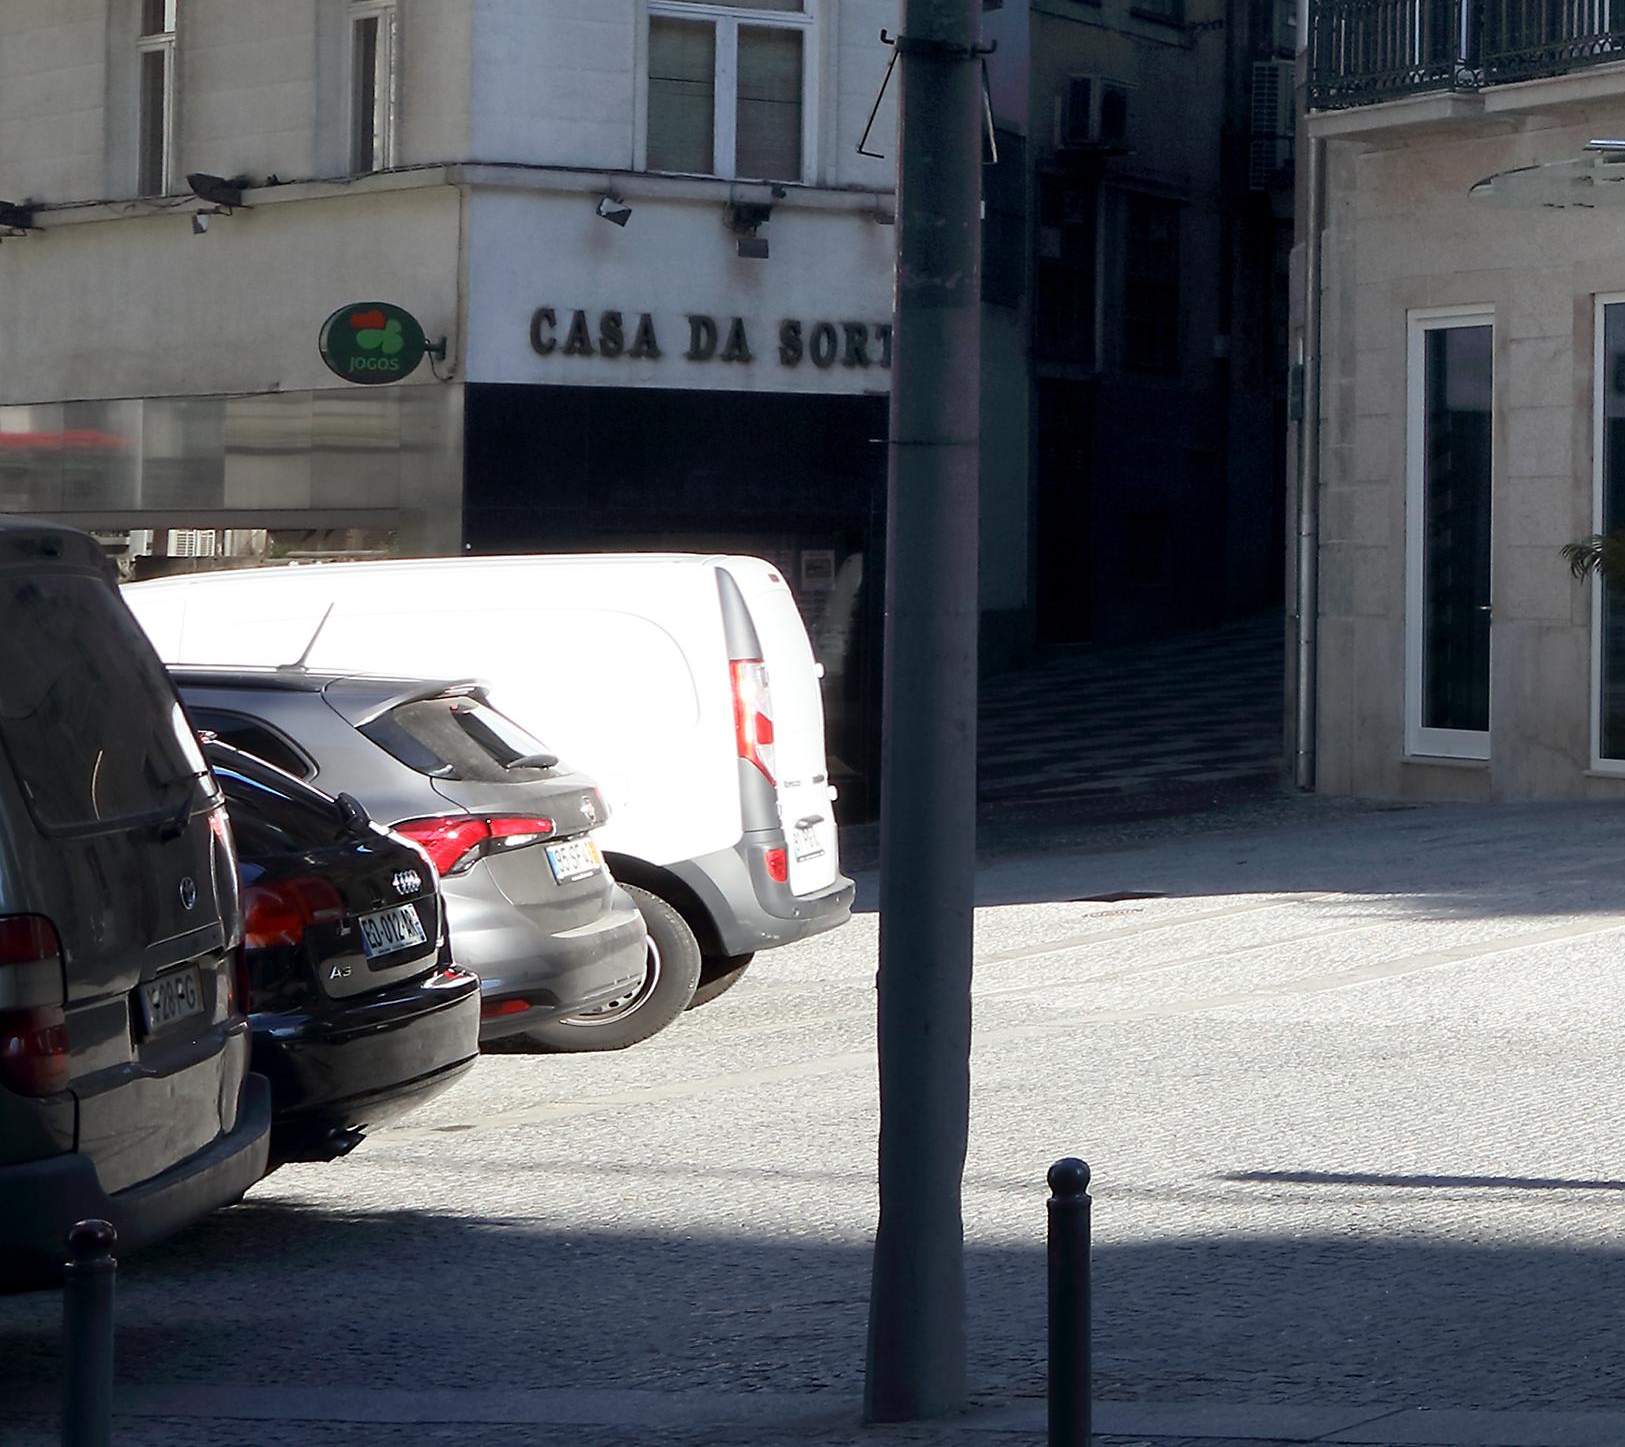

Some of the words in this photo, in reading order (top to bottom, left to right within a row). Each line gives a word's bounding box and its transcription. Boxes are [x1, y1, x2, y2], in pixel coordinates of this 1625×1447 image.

[529, 307, 663, 358] CASA
[686, 314, 754, 364] DA
[349, 357, 400, 372] JOGOS
